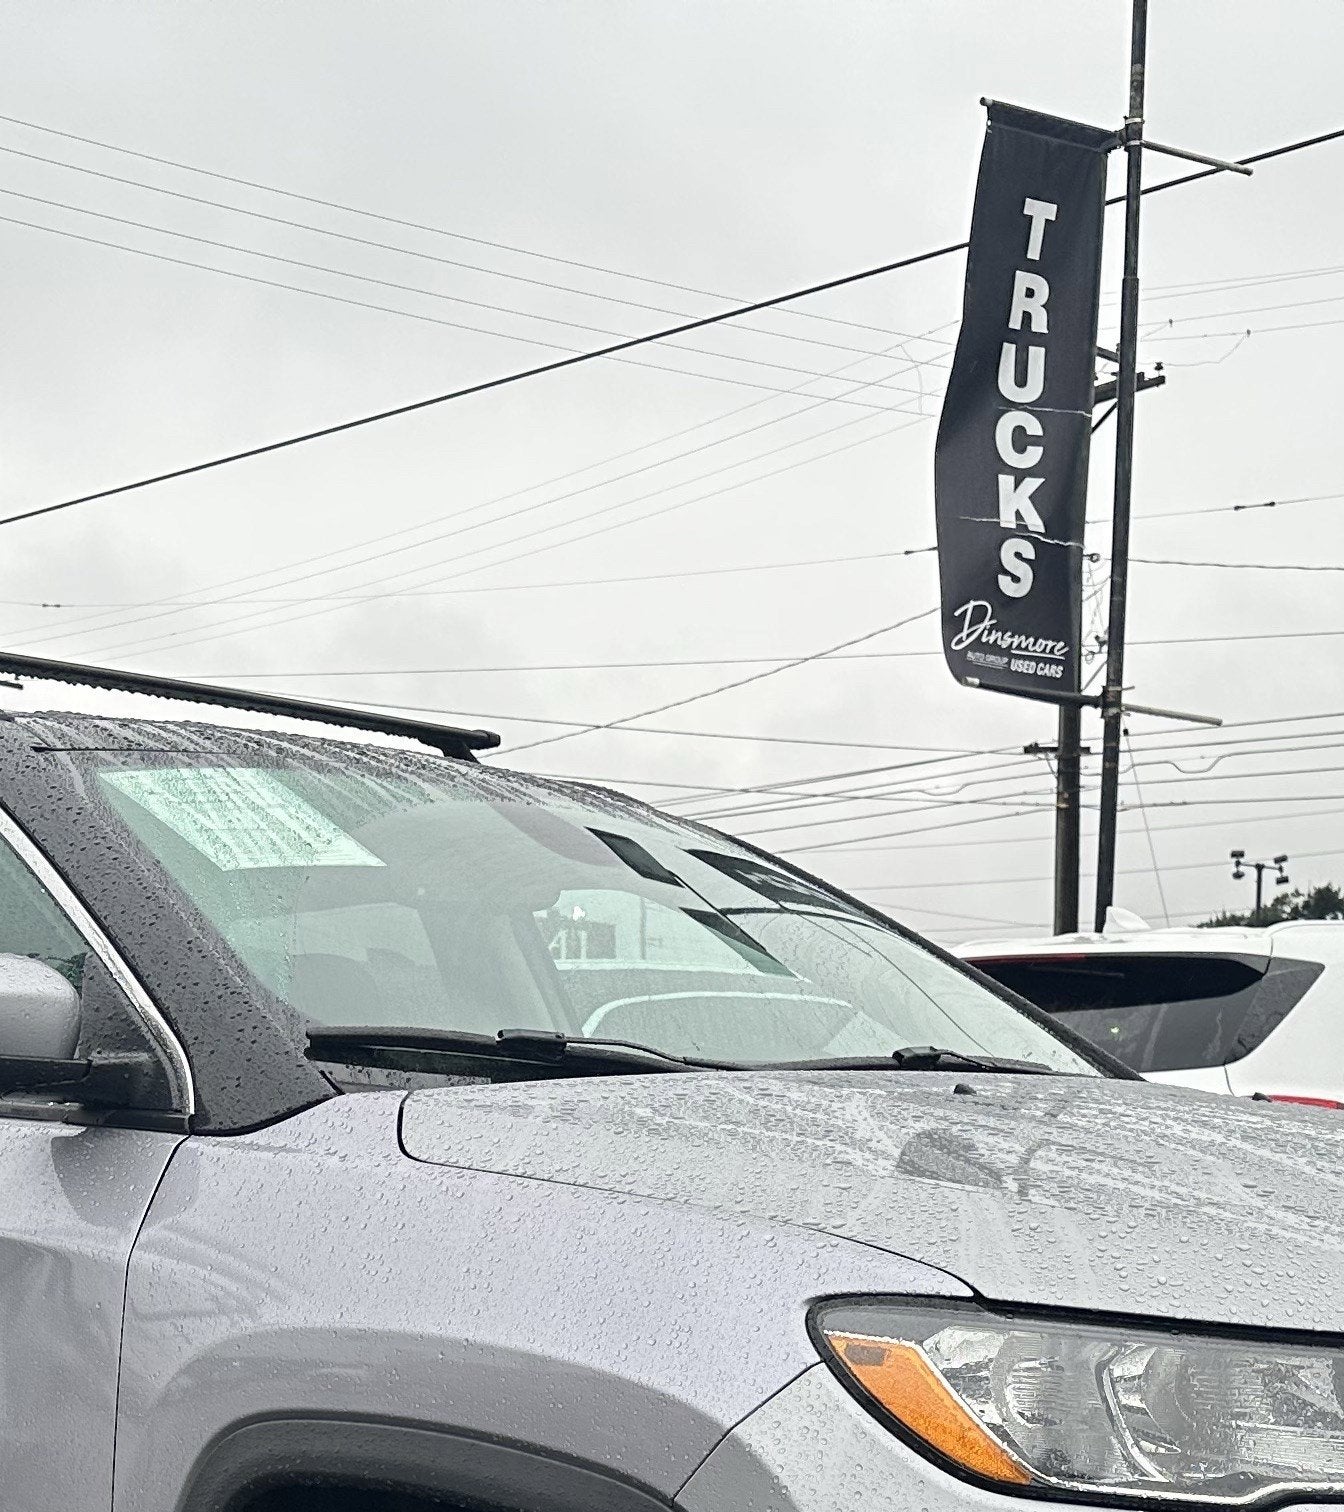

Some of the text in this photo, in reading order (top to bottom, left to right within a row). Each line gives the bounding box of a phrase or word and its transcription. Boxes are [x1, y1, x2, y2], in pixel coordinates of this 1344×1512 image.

[995, 198, 1058, 598] TRUCKS
[951, 600, 1069, 656] Dinsmore
[1010, 658, 1036, 674] USED
[1036, 661, 1064, 678] CARS
